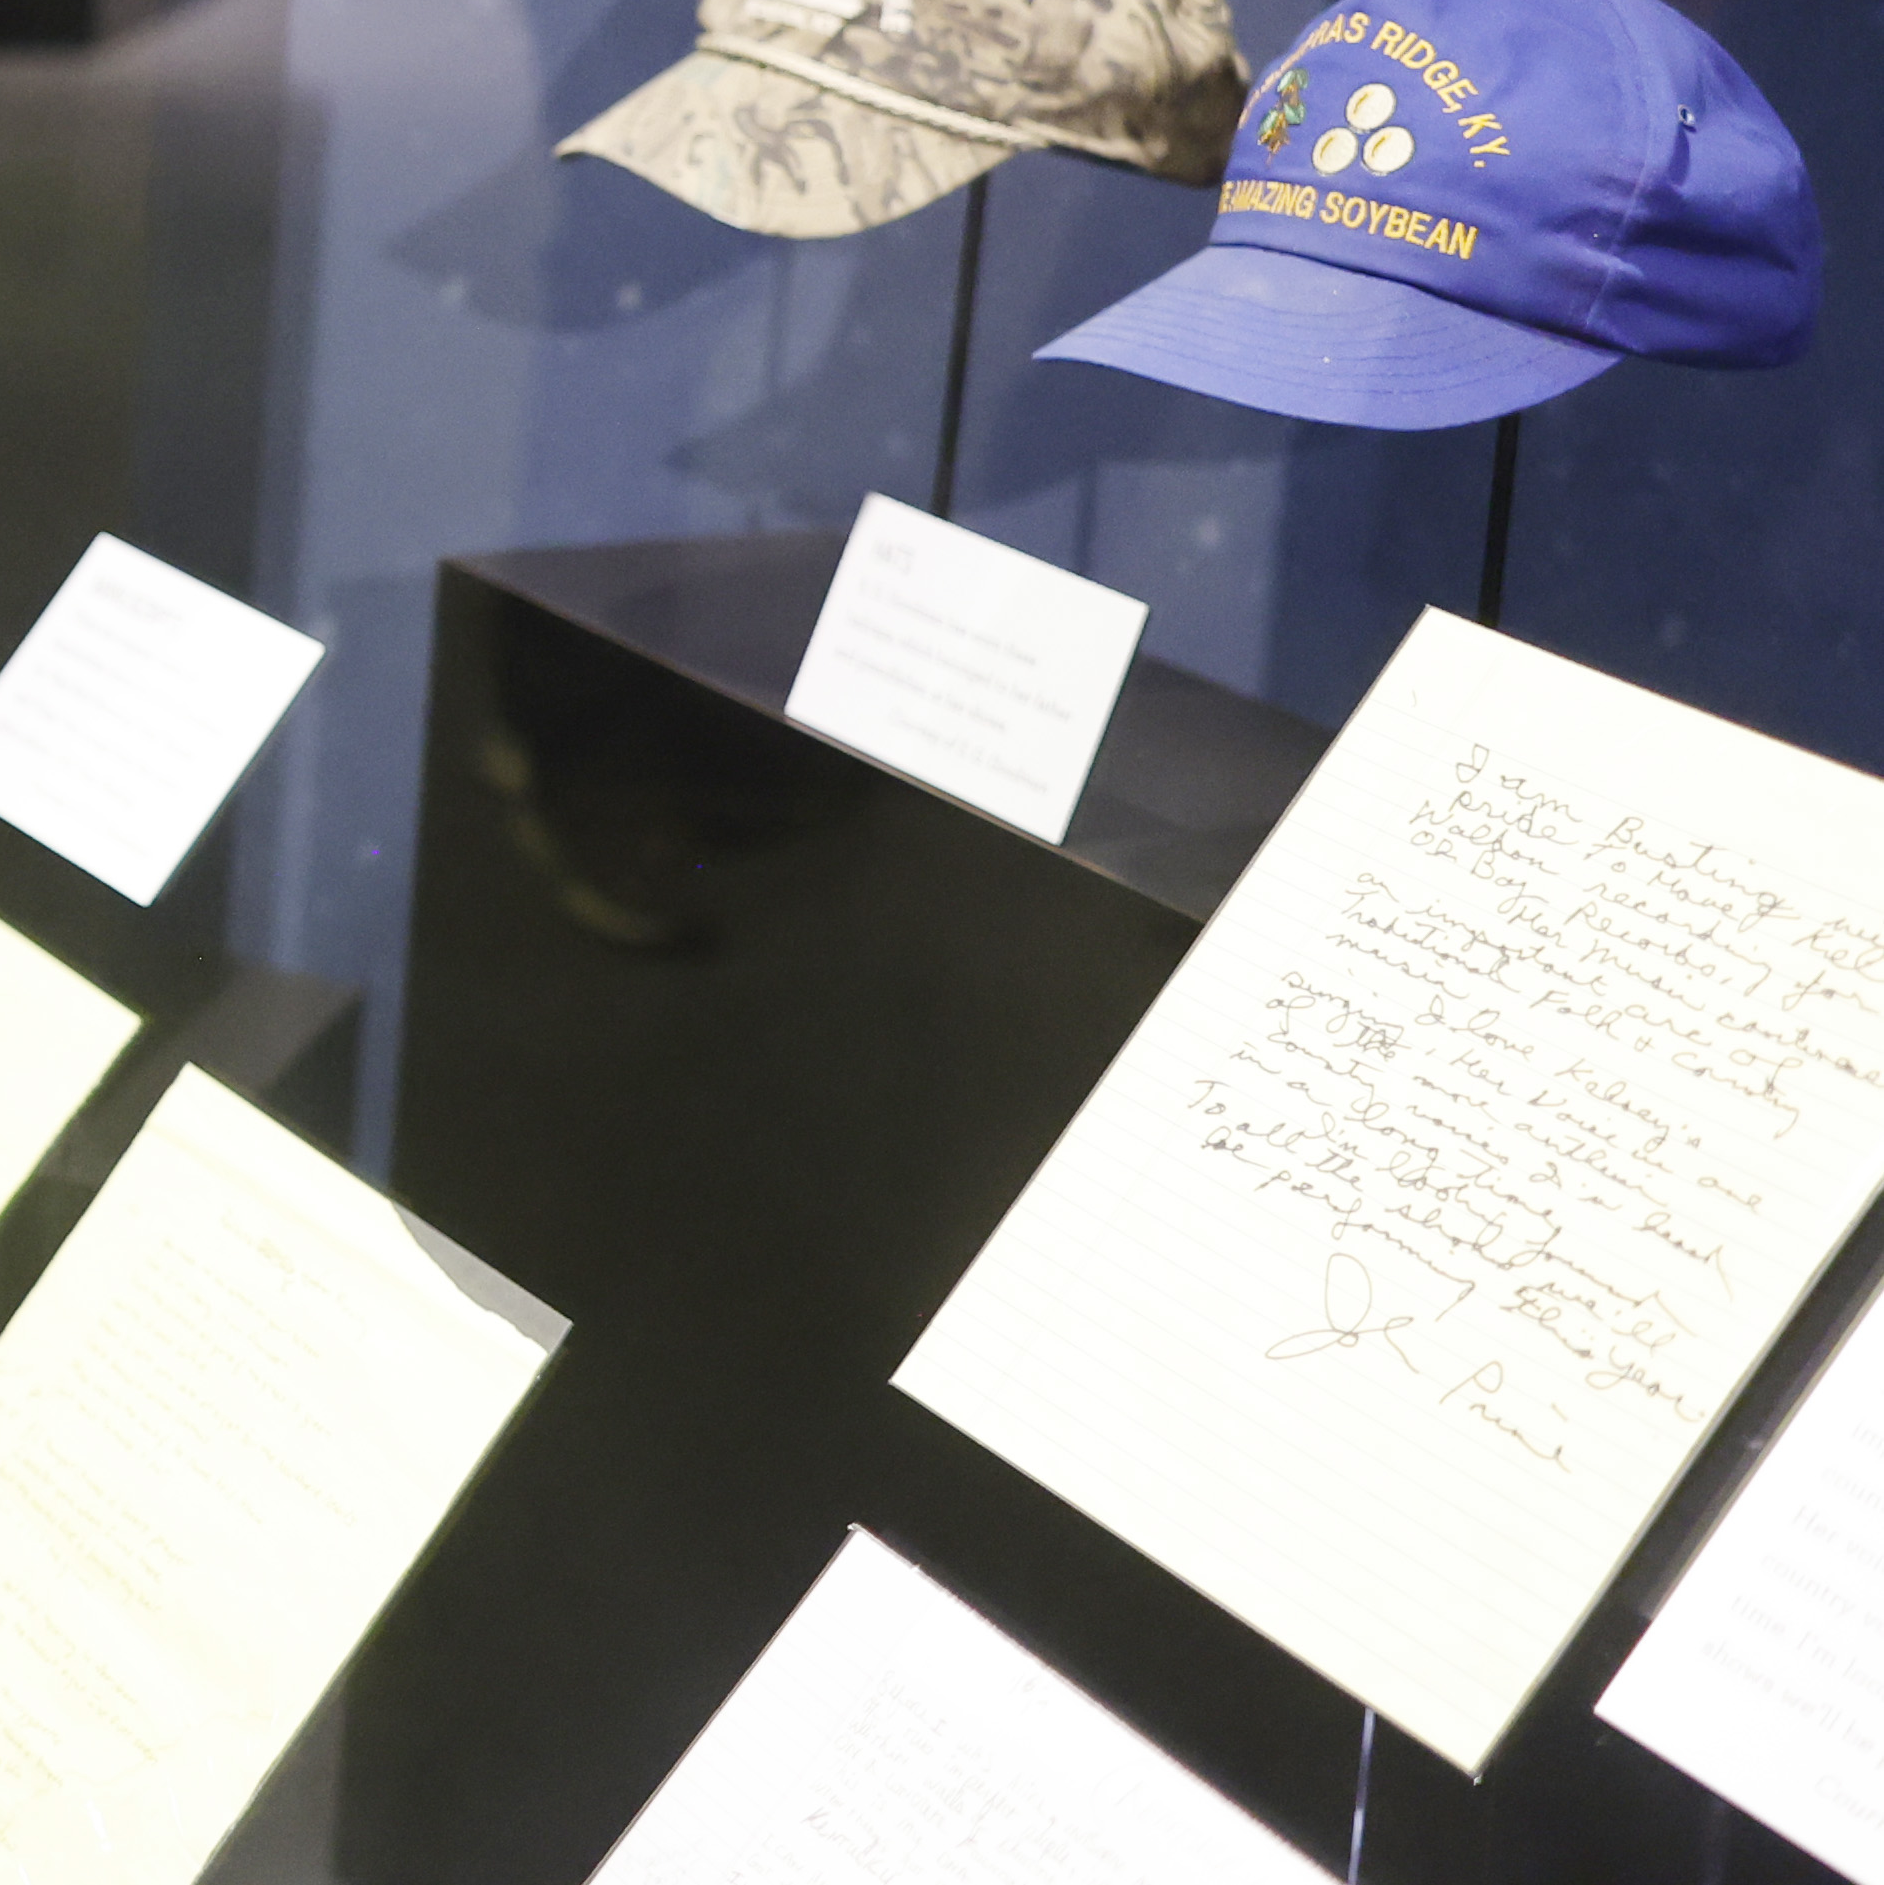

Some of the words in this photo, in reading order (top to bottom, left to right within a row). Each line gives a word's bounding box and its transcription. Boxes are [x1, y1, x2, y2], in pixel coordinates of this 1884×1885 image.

[1370, 20, 1479, 114] RIDGE,
[1457, 112, 1511, 168] KY.
[1232, 179, 1318, 220] AMAZING
[1319, 190, 1480, 261] SOYBEAN
[1499, 774, 1583, 824] am
[1447, 789, 1575, 846] pride
[1792, 929, 1884, 984] Kel
[1469, 849, 1550, 915] Boy
[1356, 872, 1400, 903] an
[1404, 905, 1607, 997] important
[1728, 1048, 1804, 1086] of
[1582, 882, 1773, 998] recording
[1781, 970, 1876, 1013] for
[1264, 994, 1311, 1020] of
[1339, 1023, 1412, 1063] the
[1448, 1007, 1535, 1060] love
[1528, 989, 1623, 1041] Folk
[1228, 1041, 1282, 1076] in
[1285, 1080, 1332, 1107] a
[1342, 1097, 1440, 1167] long
[1235, 1121, 1308, 1155] all
[1306, 1148, 1363, 1193] the
[1696, 1176, 1763, 1213] one
[1254, 1169, 1477, 1322] performing
[1819, 1464, 1884, 1514] coun
[1791, 1502, 1841, 1546] Her
[1759, 1549, 1857, 1618] country
[1795, 1627, 1838, 1671] I'm
[1699, 1638, 1777, 1695] shows
[1779, 1687, 1839, 1734] we'll
[1841, 1715, 1876, 1755] be
